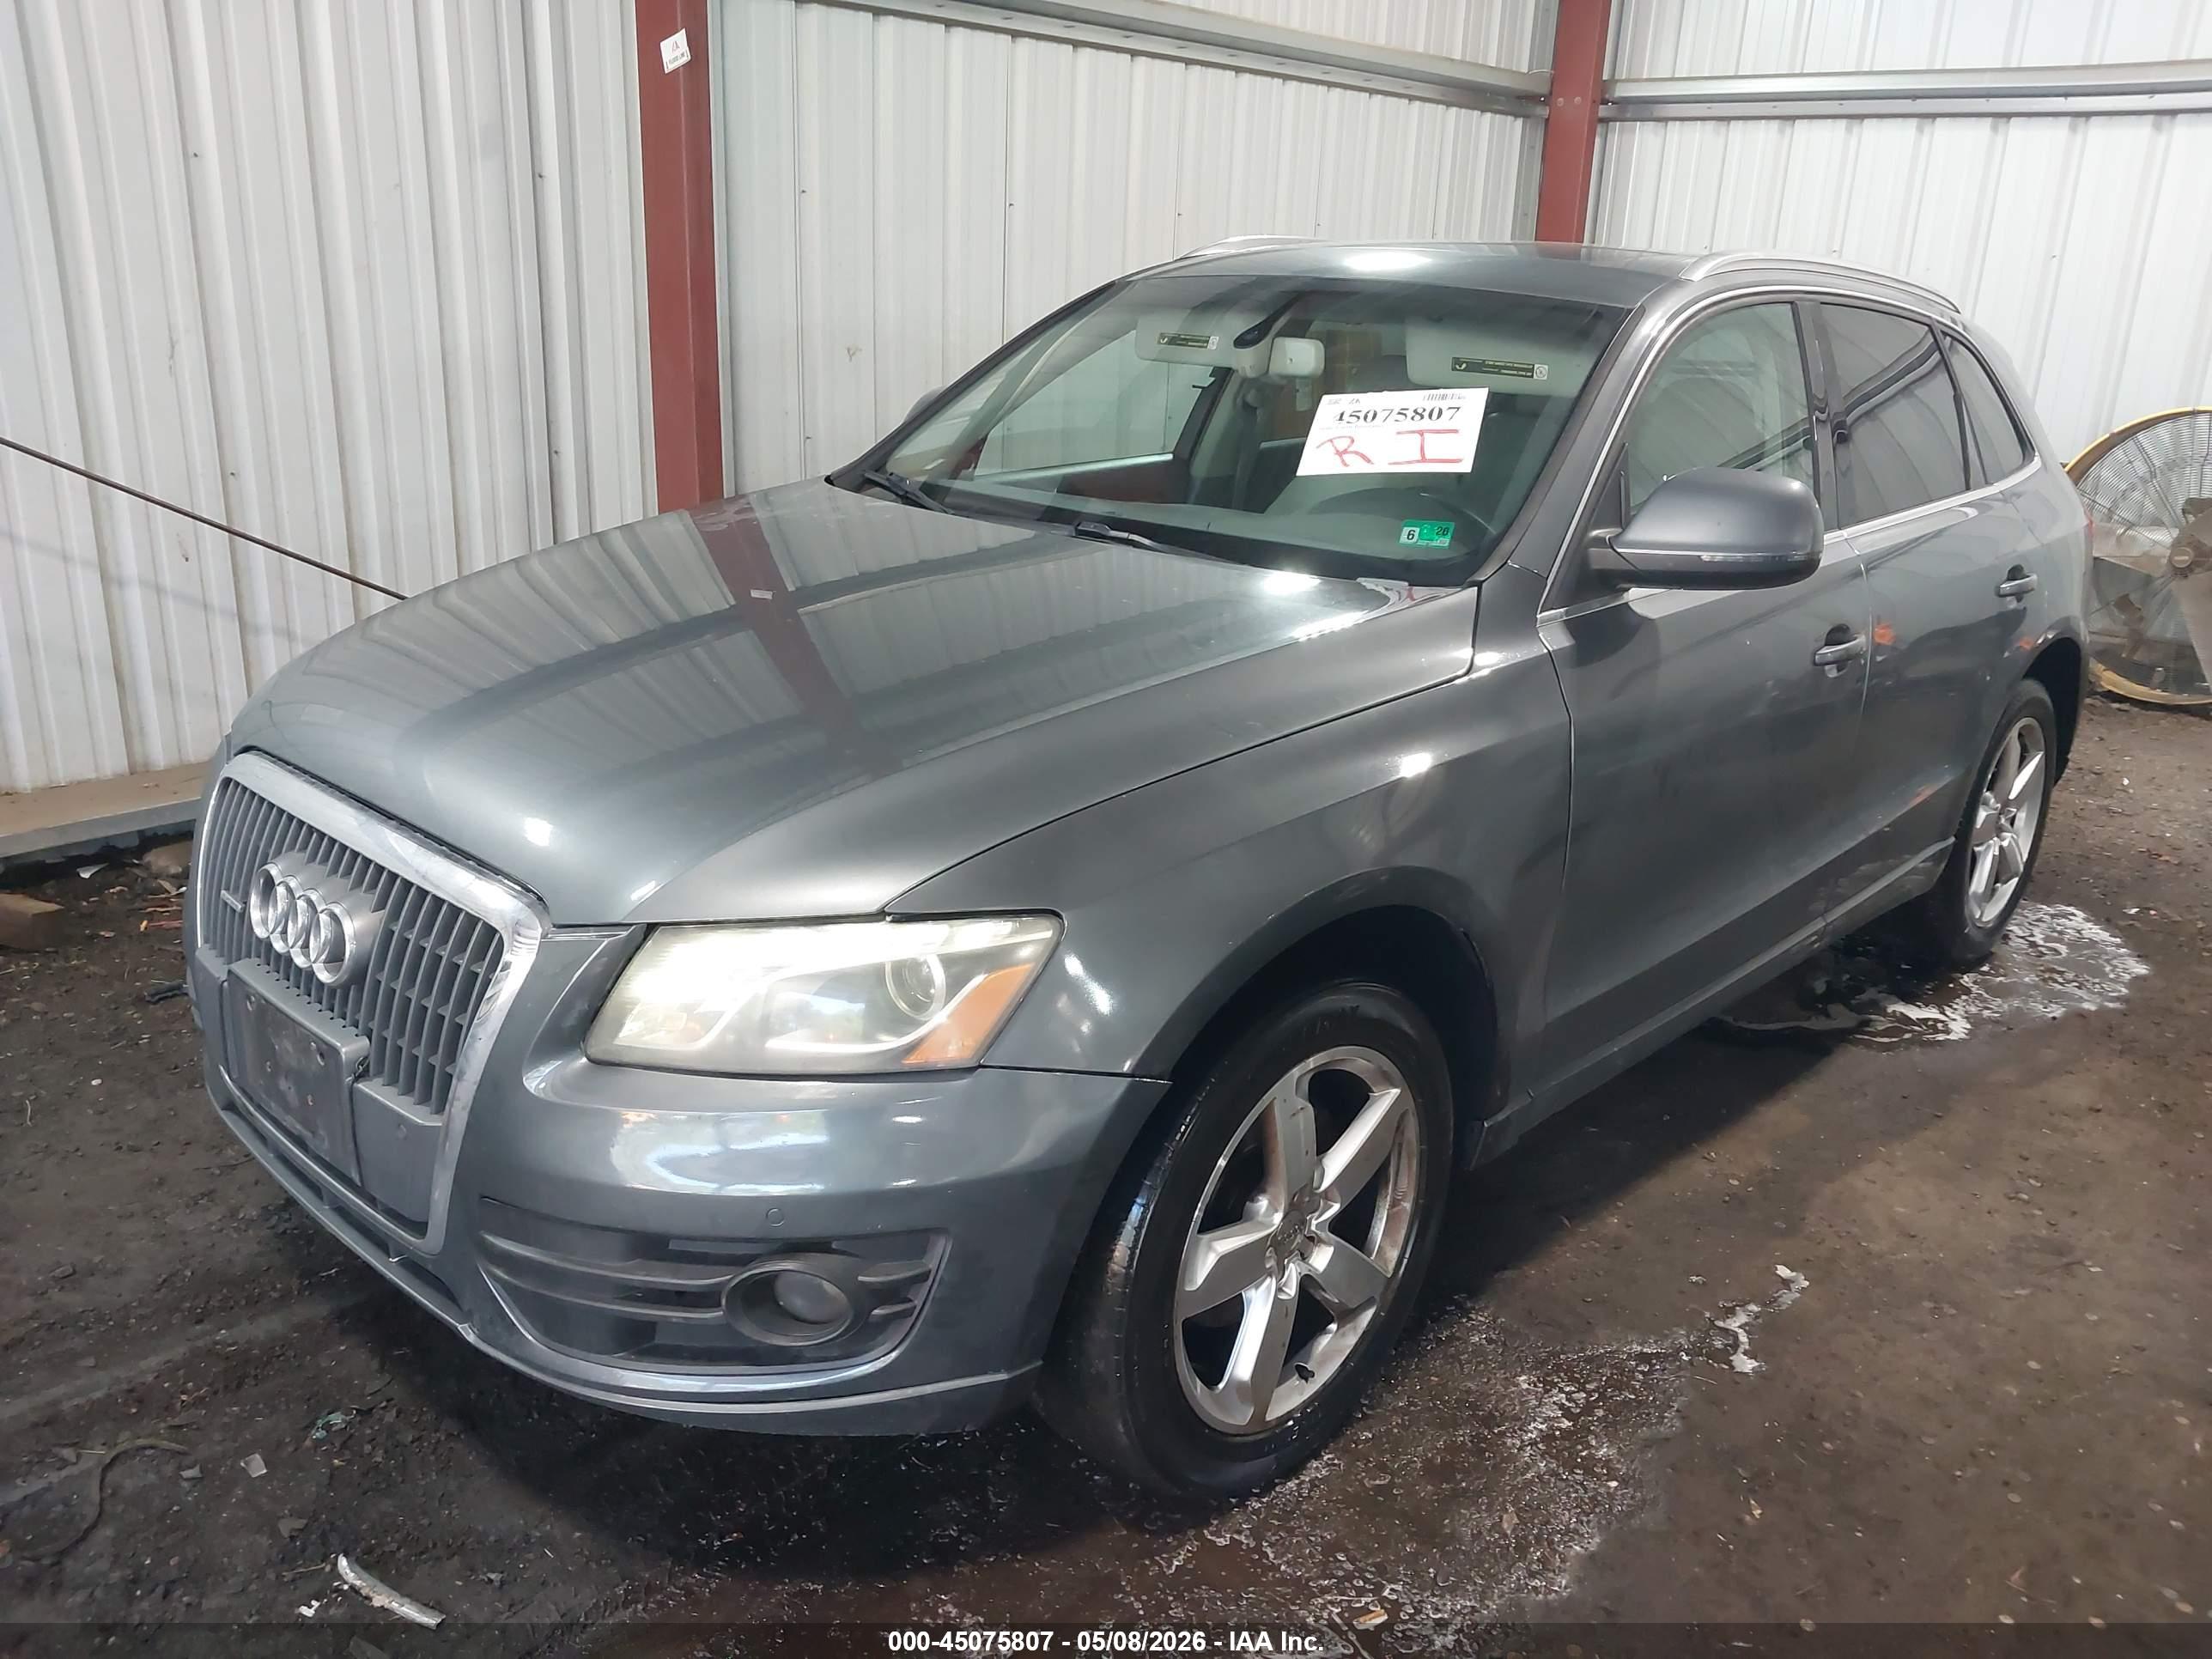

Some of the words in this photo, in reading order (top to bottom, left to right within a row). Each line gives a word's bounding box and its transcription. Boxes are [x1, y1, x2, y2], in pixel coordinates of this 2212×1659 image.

[1333, 406, 1462, 424] 45075807
[1316, 435, 1375, 467] R
[1407, 529, 1416, 540] 6
